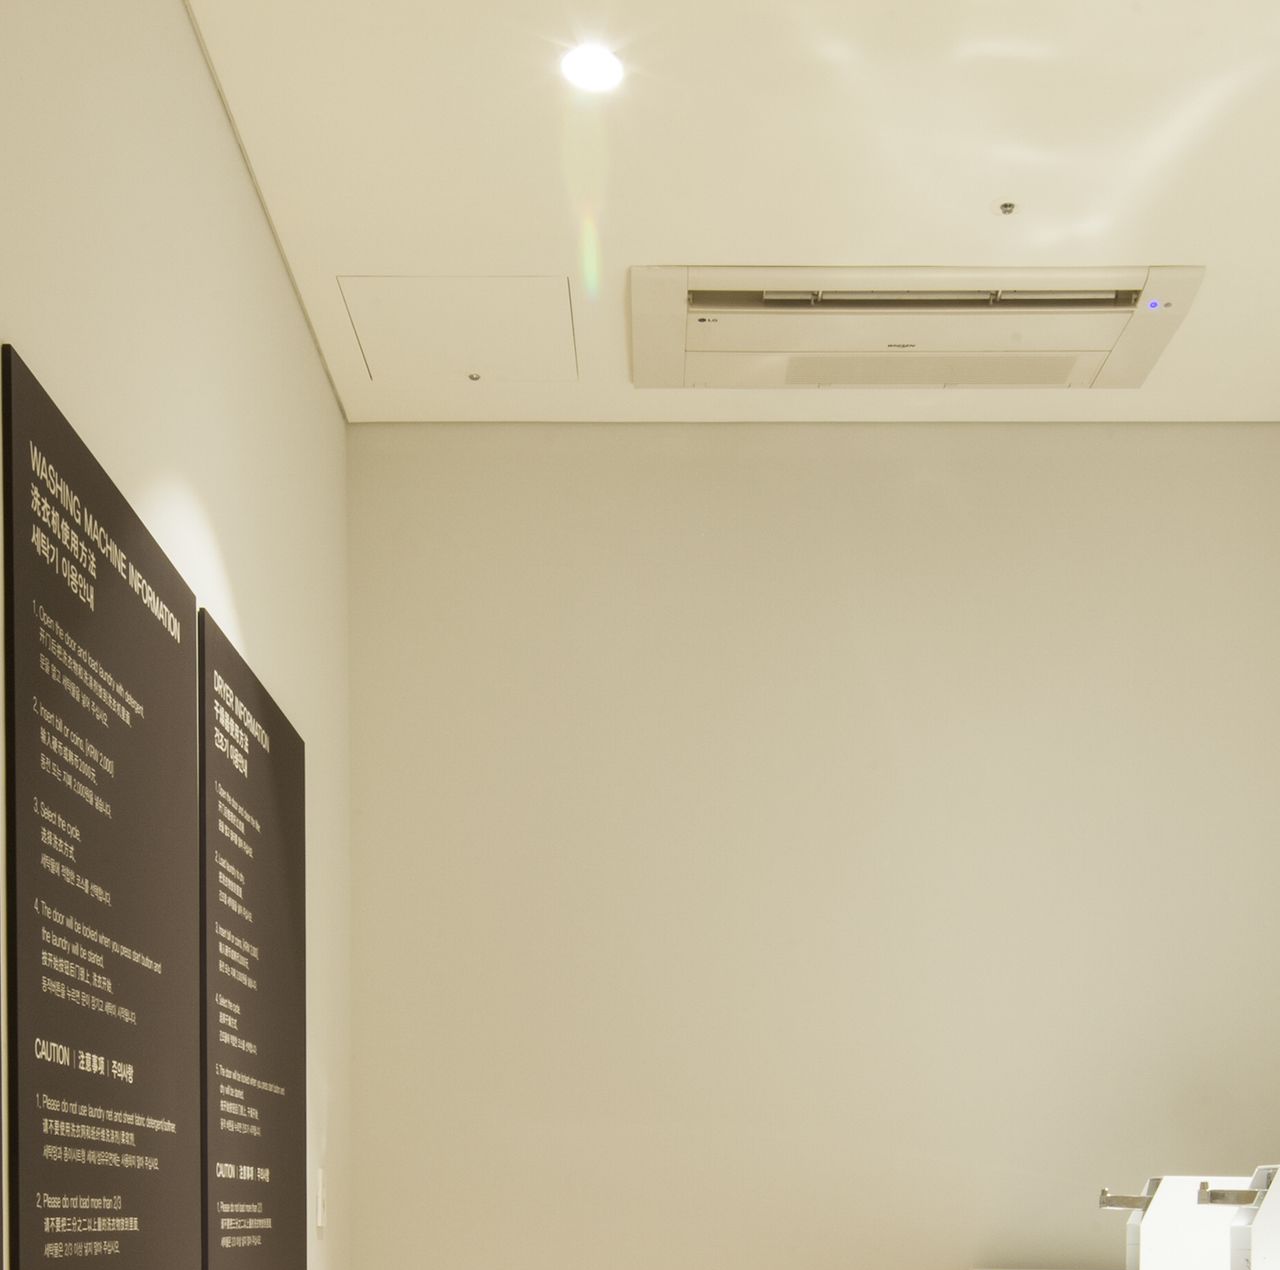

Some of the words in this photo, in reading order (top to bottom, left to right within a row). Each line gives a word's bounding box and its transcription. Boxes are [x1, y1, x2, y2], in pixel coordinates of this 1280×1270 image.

[30, 441, 81, 525] WASHING
[84, 508, 127, 580] MACHINE
[129, 562, 181, 644] INFORMATION
[31, 483, 97, 579] 洗衣机使用方法
[31, 524, 59, 574] 세탁기
[62, 557, 94, 612] 이용안내
[35, 1038, 70, 1066] CAUTION
